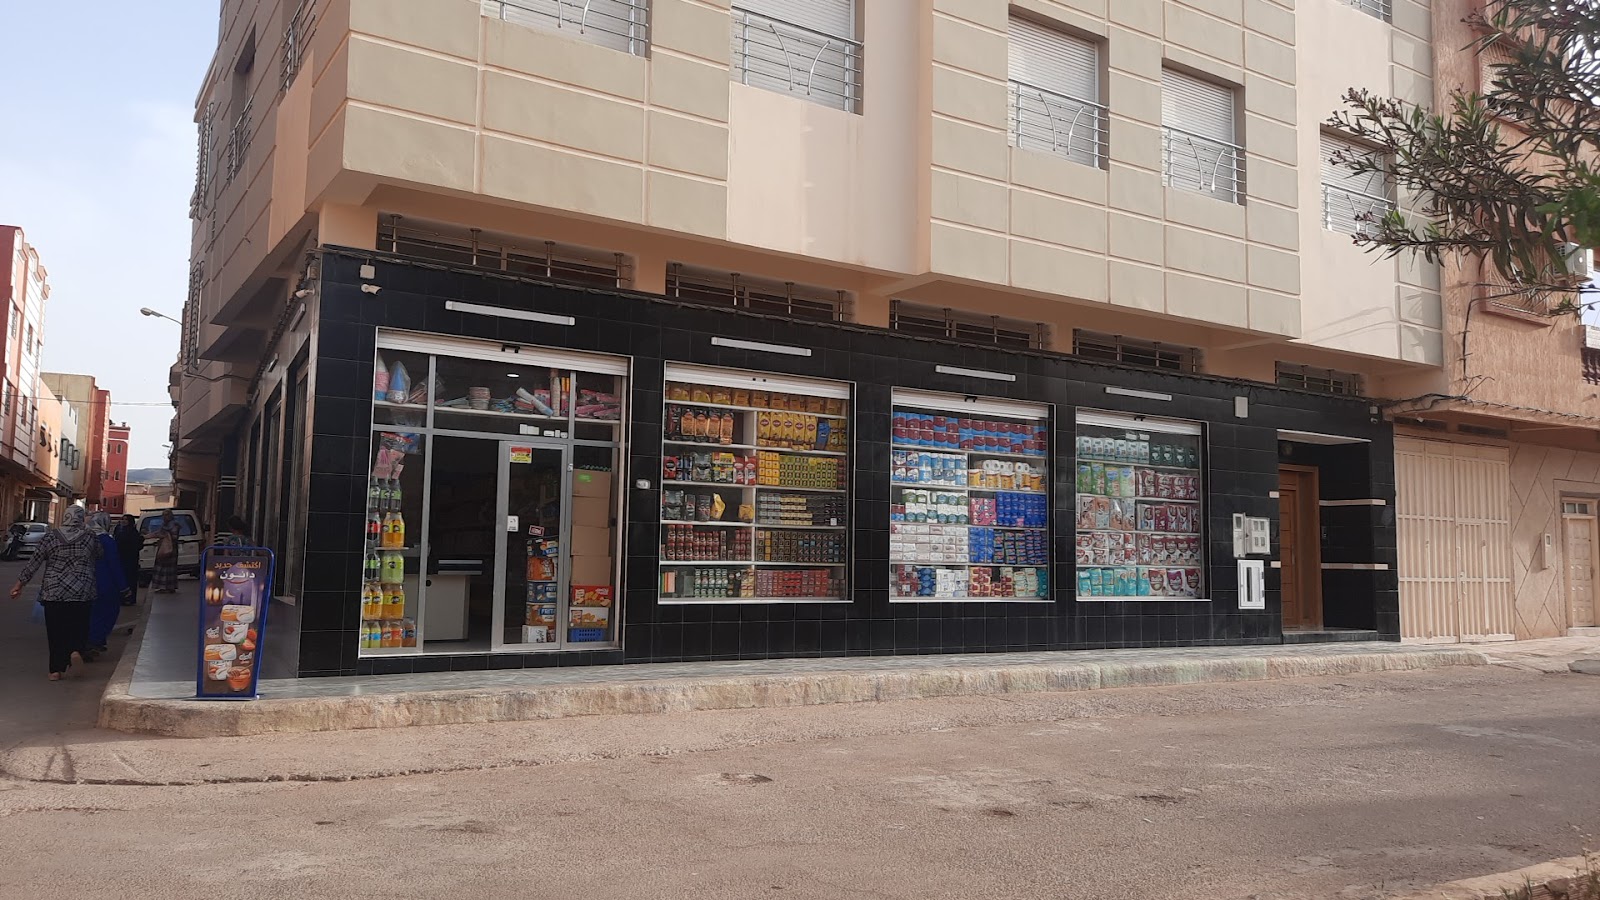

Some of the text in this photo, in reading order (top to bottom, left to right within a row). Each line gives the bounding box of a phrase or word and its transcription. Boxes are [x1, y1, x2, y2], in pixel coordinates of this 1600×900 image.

[214, 560, 261, 570] اكتشف جديد
[220, 570, 256, 580] دانون
